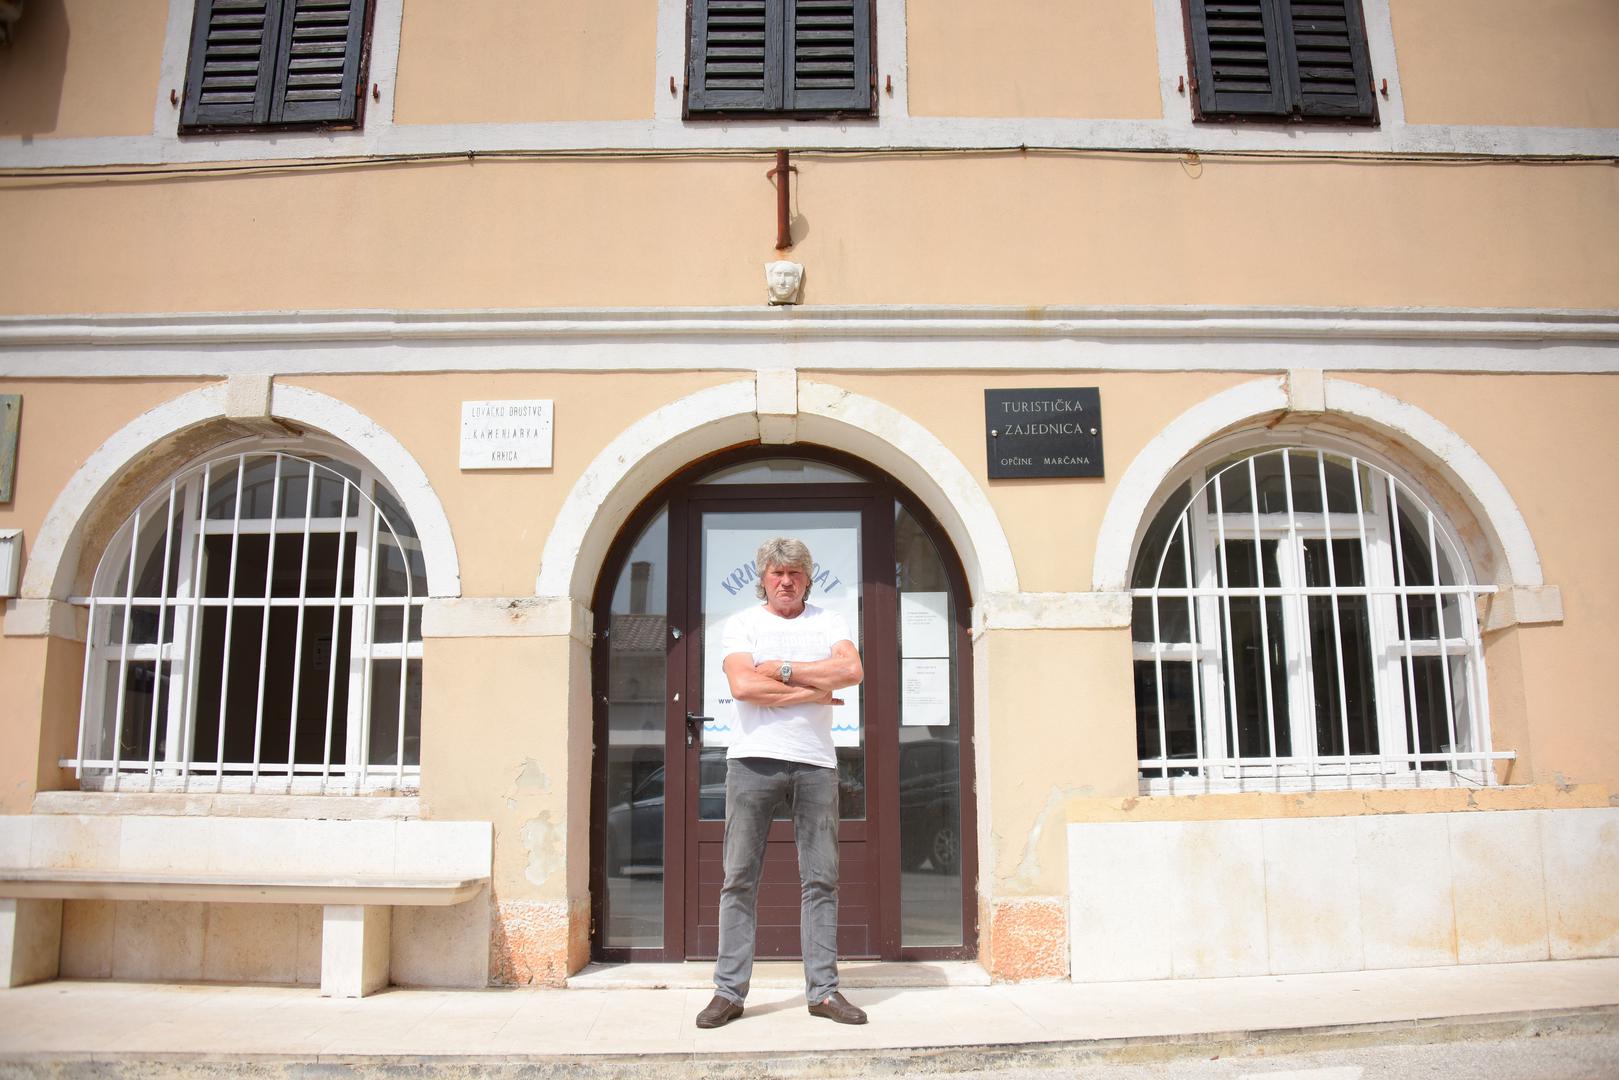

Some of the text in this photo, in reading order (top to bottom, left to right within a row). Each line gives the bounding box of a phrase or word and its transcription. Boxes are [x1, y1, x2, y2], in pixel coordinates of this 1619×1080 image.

[1002, 399, 1083, 413] TURISTIČKA
[1005, 423, 1083, 435] ZAJEDNICA
[1043, 455, 1090, 465] MARČANA
